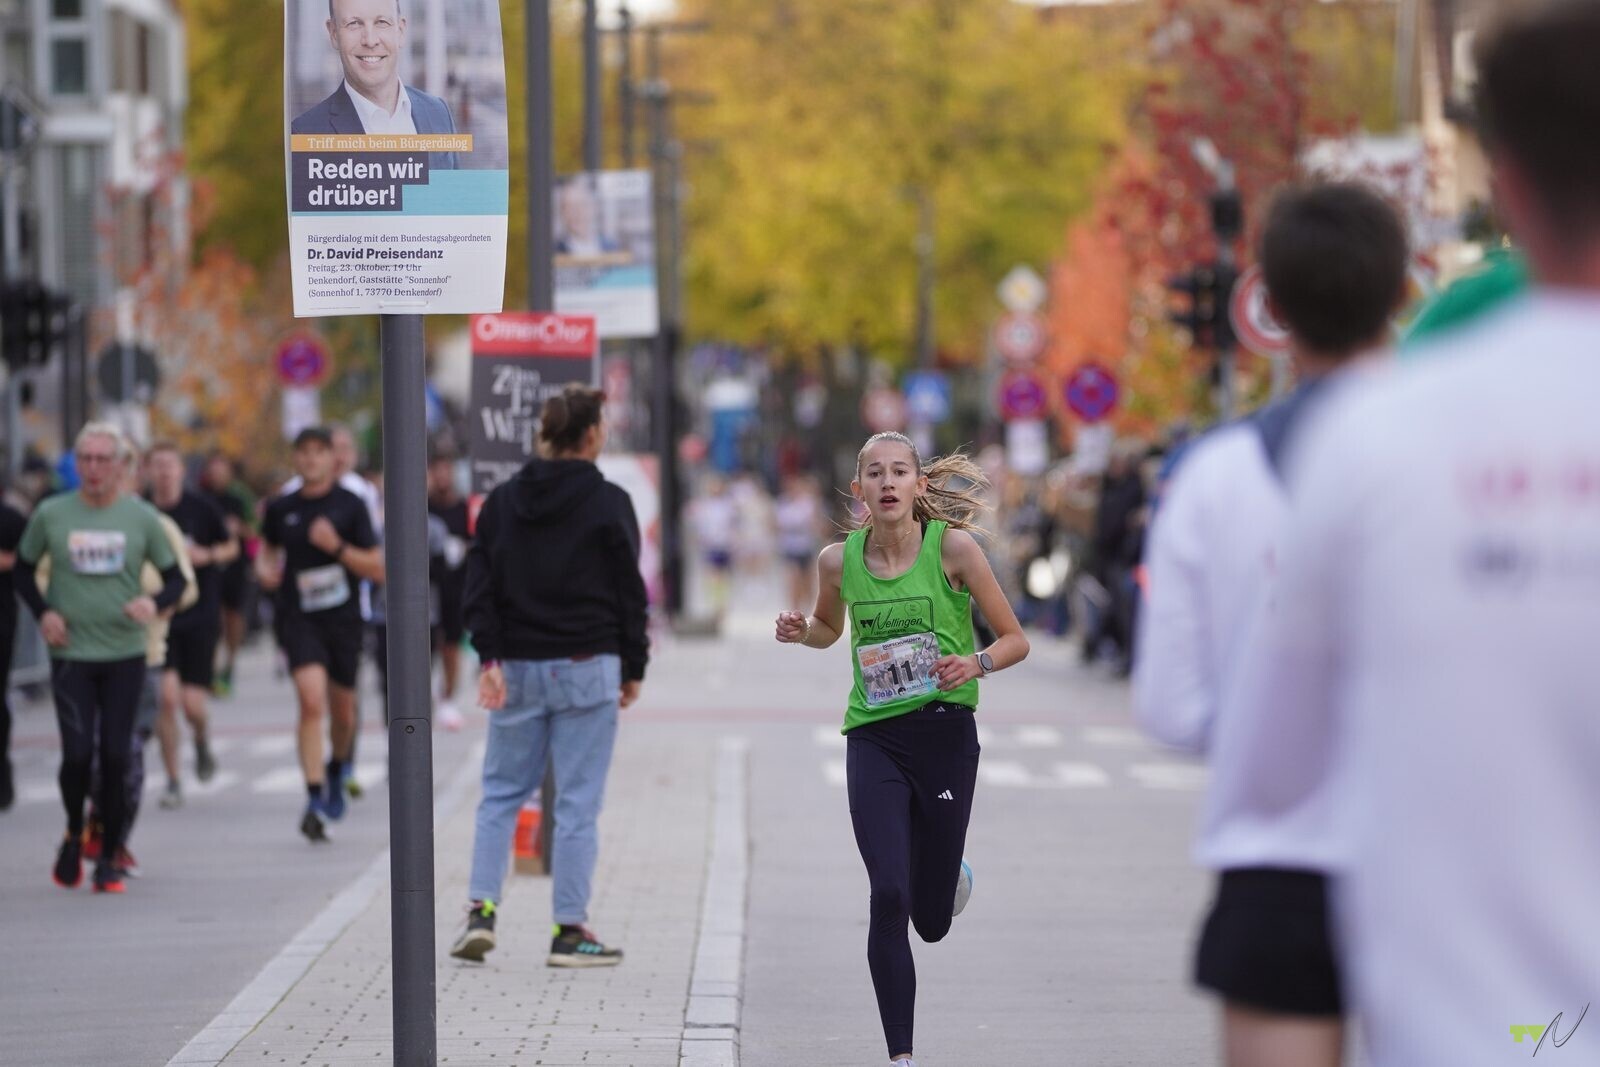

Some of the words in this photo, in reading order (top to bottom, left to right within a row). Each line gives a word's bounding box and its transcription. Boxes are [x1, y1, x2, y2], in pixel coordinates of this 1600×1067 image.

[307, 137, 335, 149] Triff
[337, 137, 366, 149] mich
[368, 137, 397, 149] beim
[400, 137, 468, 151] Bürgerdialog
[308, 158, 382, 179] Reden
[388, 157, 423, 179] wir
[308, 184, 395, 206] drüber!
[307, 234, 362, 245] Bürgerdialog
[364, 234, 379, 243] mit
[380, 234, 399, 243] dem
[400, 234, 492, 244] Bundestagsabgeordneten
[307, 249, 325, 260] Dr.
[327, 248, 363, 260] David
[366, 248, 443, 260] Preisendanz
[308, 264, 338, 274] Freitag,
[340, 263, 353, 273] 23.
[354, 263, 391, 273] Oktober,
[393, 263, 404, 272] 19
[405, 263, 422, 272] Uhr
[308, 276, 358, 286] Denkendorf,
[359, 275, 403, 284] Gaststätte
[405, 275, 452, 285] "Sonnenhof"
[308, 288, 354, 299] (Sonnenhof
[356, 288, 363, 298] 1,
[365, 287, 392, 297] 73770
[394, 287, 442, 298] Denkendorf)
[871, 606, 923, 635] Nellingen
[887, 660, 914, 685] 11
